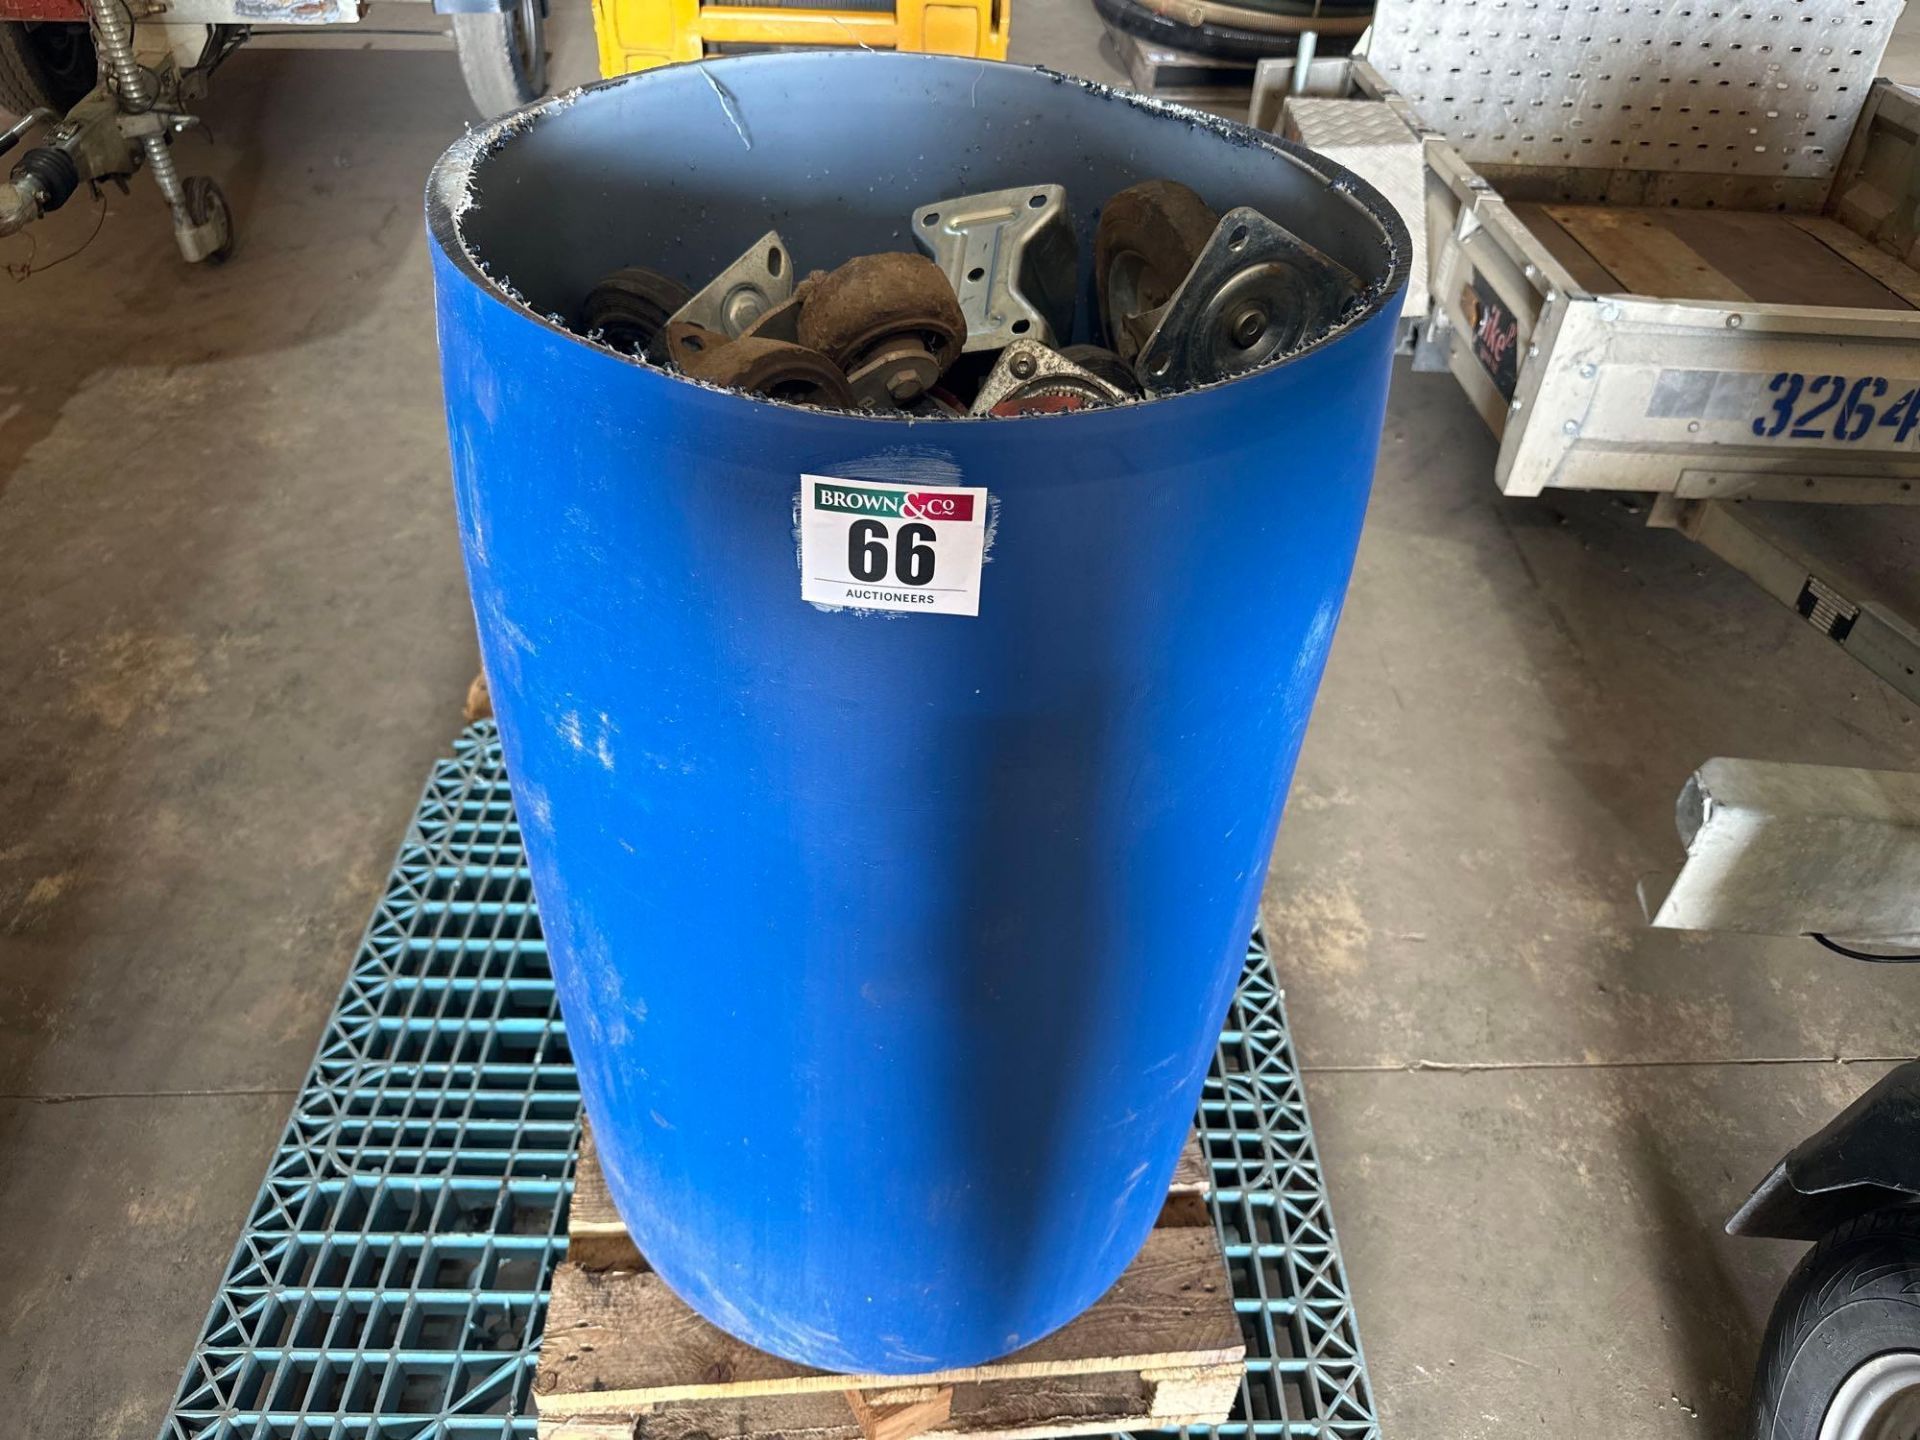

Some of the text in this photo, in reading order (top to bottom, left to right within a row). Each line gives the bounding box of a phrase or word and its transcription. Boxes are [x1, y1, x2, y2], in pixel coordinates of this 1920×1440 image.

[1752, 372, 1920, 443] 3264
[848, 519, 937, 586] 66
[846, 589, 935, 604] AUCTIONEERS
